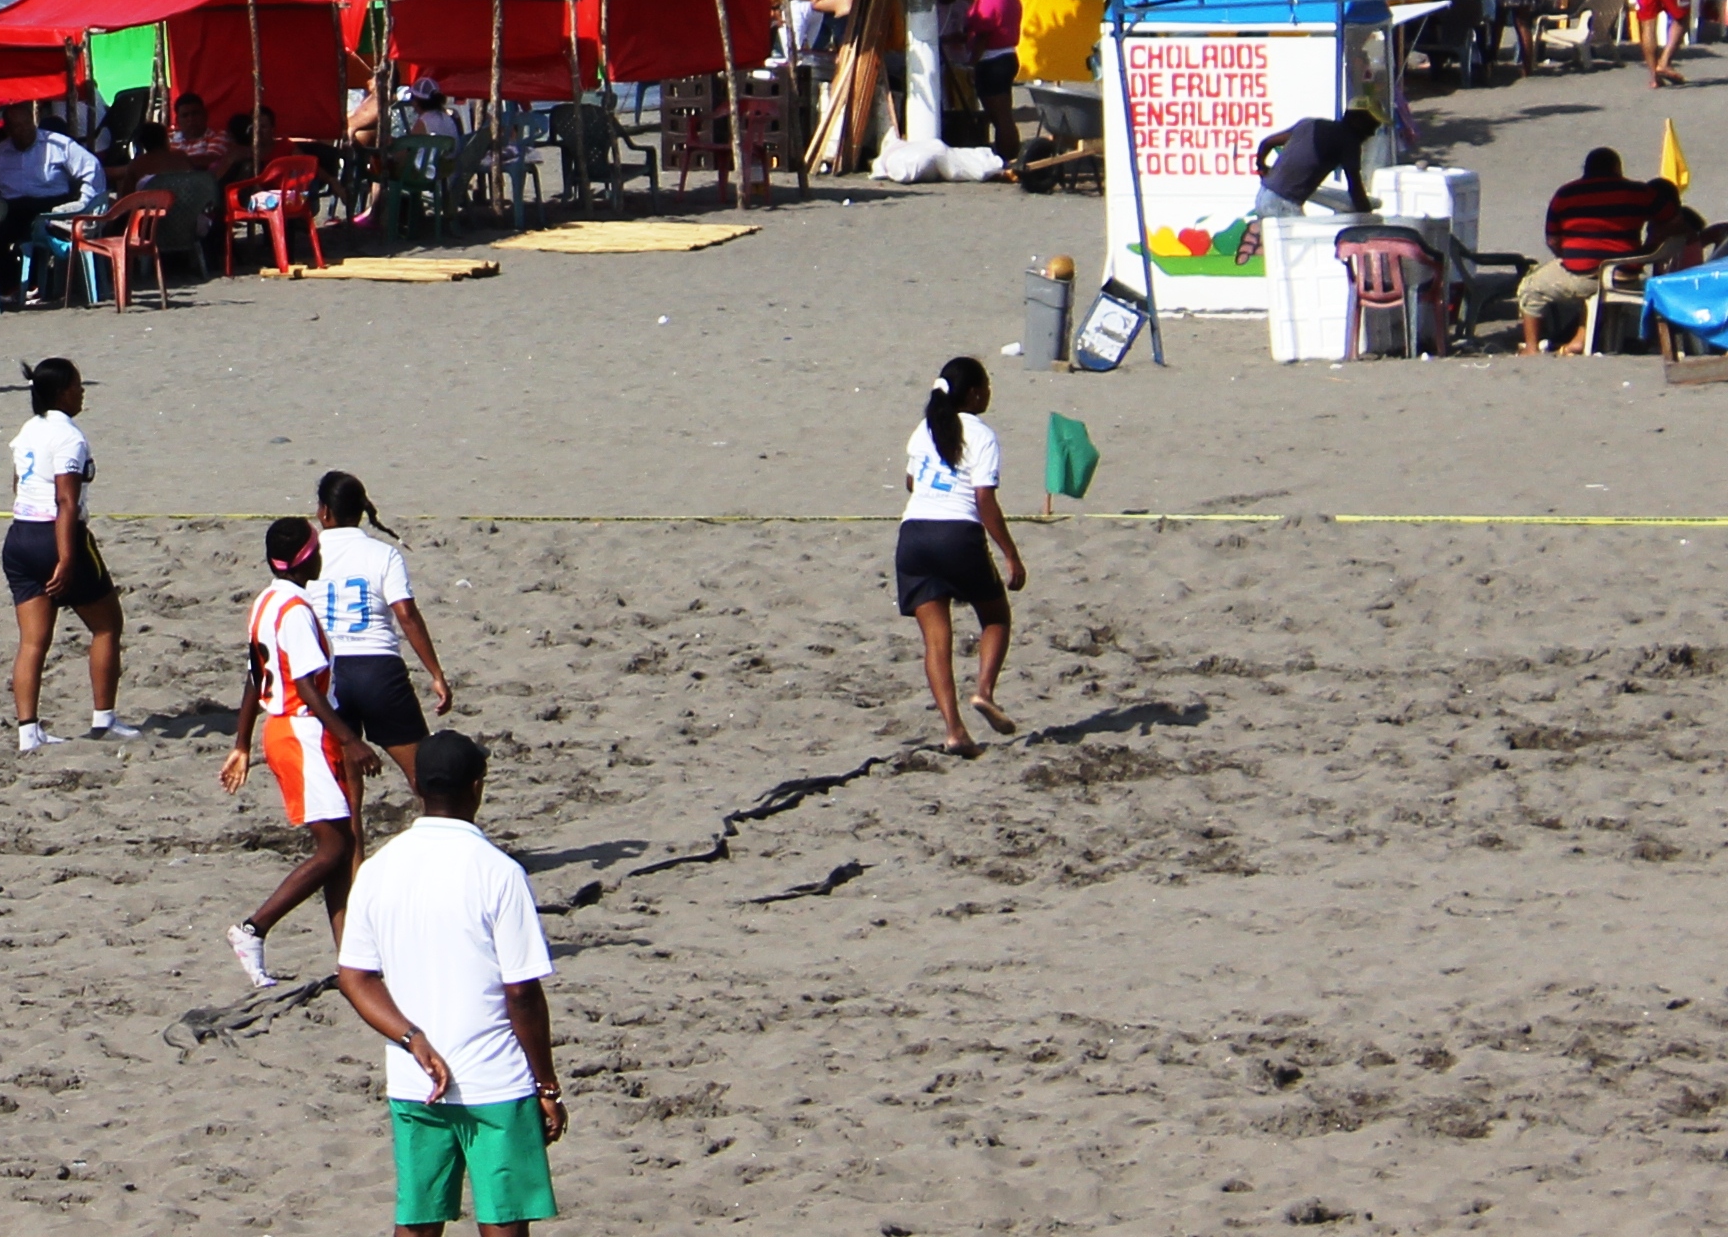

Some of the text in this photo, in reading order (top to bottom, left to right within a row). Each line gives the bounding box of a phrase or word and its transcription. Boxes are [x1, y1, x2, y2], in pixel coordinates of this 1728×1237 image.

[1130, 44, 1268, 69] CHOLADOS
[1130, 73, 1267, 98] DE FRUTAS
[1131, 101, 1274, 127] ENSALADAS
[1134, 129, 1254, 150] DE FRUTAS
[327, 577, 370, 633] 13
